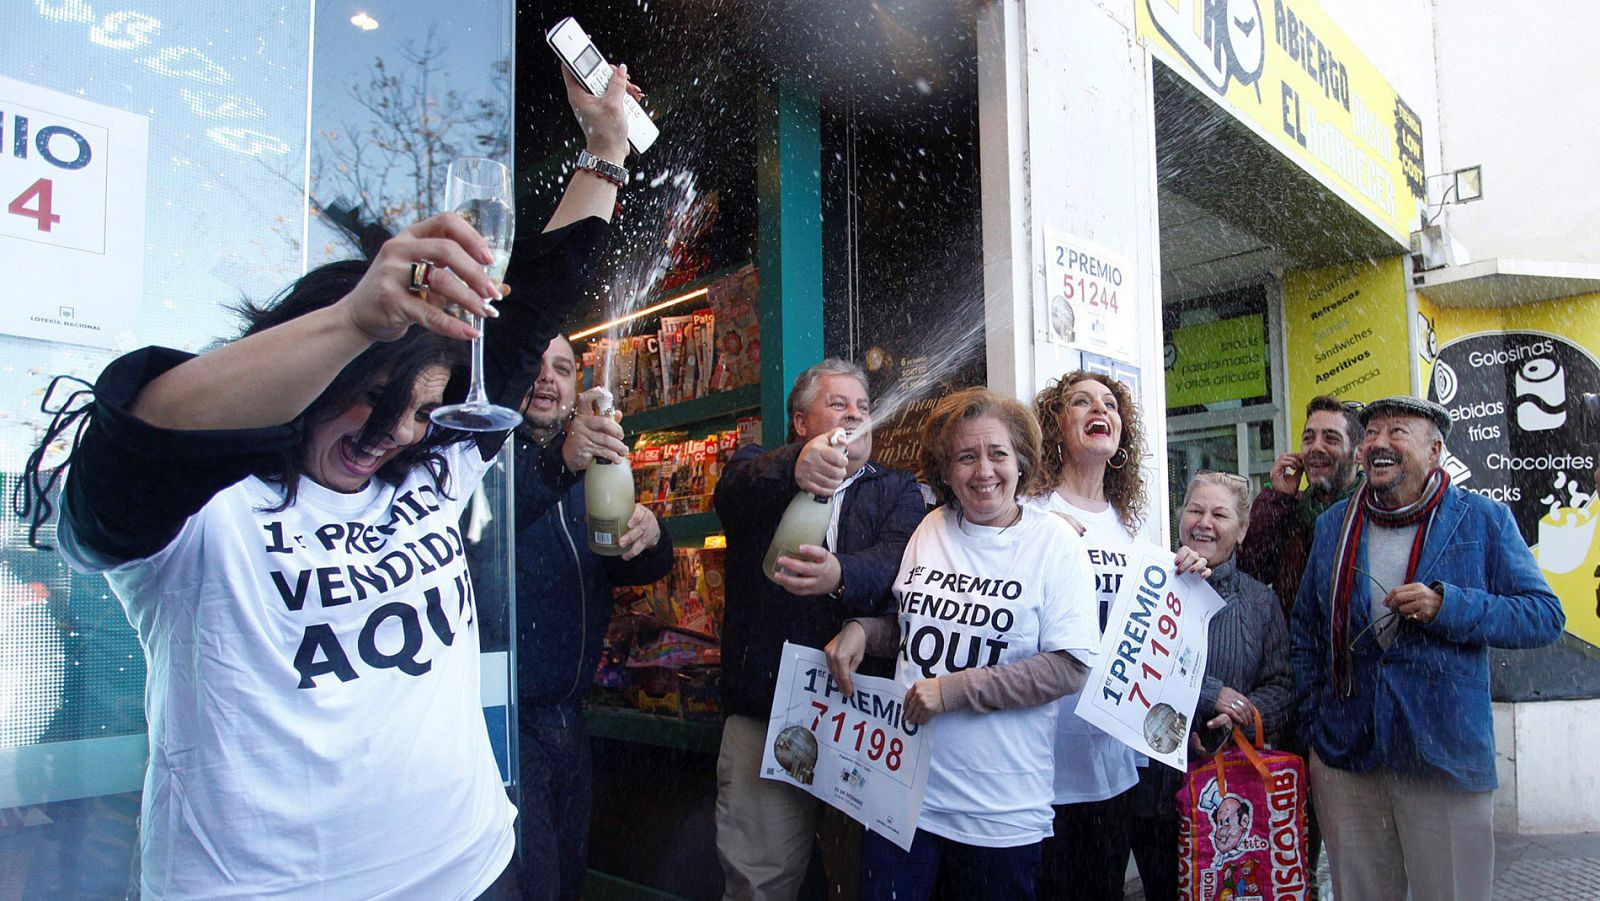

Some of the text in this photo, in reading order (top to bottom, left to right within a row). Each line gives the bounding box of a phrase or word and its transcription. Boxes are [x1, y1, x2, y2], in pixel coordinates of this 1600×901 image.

[1281, 80, 1307, 149] EL
[0, 110, 92, 171] IO
[1401, 153, 1423, 186] COST
[1069, 249, 1123, 287] PREMIO
[1063, 273, 1119, 314] 51244
[1310, 289, 1361, 321] Refrescos
[63, 321, 102, 331] NACIONAL
[1314, 326, 1373, 364] Sandwiches
[1468, 339, 1554, 368] Golosinas
[1315, 350, 1371, 385] Aperitivos
[1450, 400, 1505, 422] ebidas
[1468, 423, 1501, 443] frías
[1486, 453, 1594, 470] Chocolates
[1459, 485, 1521, 502] nacks
[270, 526, 464, 612] VENDIDO
[1087, 549, 1127, 567] EMI
[924, 569, 1023, 601] PREMIO
[899, 590, 1014, 633] VENDIDO
[1109, 565, 1168, 685] PREMIO
[1127, 591, 1183, 710] 71198
[824, 673, 920, 737] PREMIO
[810, 700, 904, 772] 71198
[1242, 838, 1268, 850] tito
[1270, 771, 1304, 901] ISCOLAB
[1204, 872, 1215, 901] RUCA
